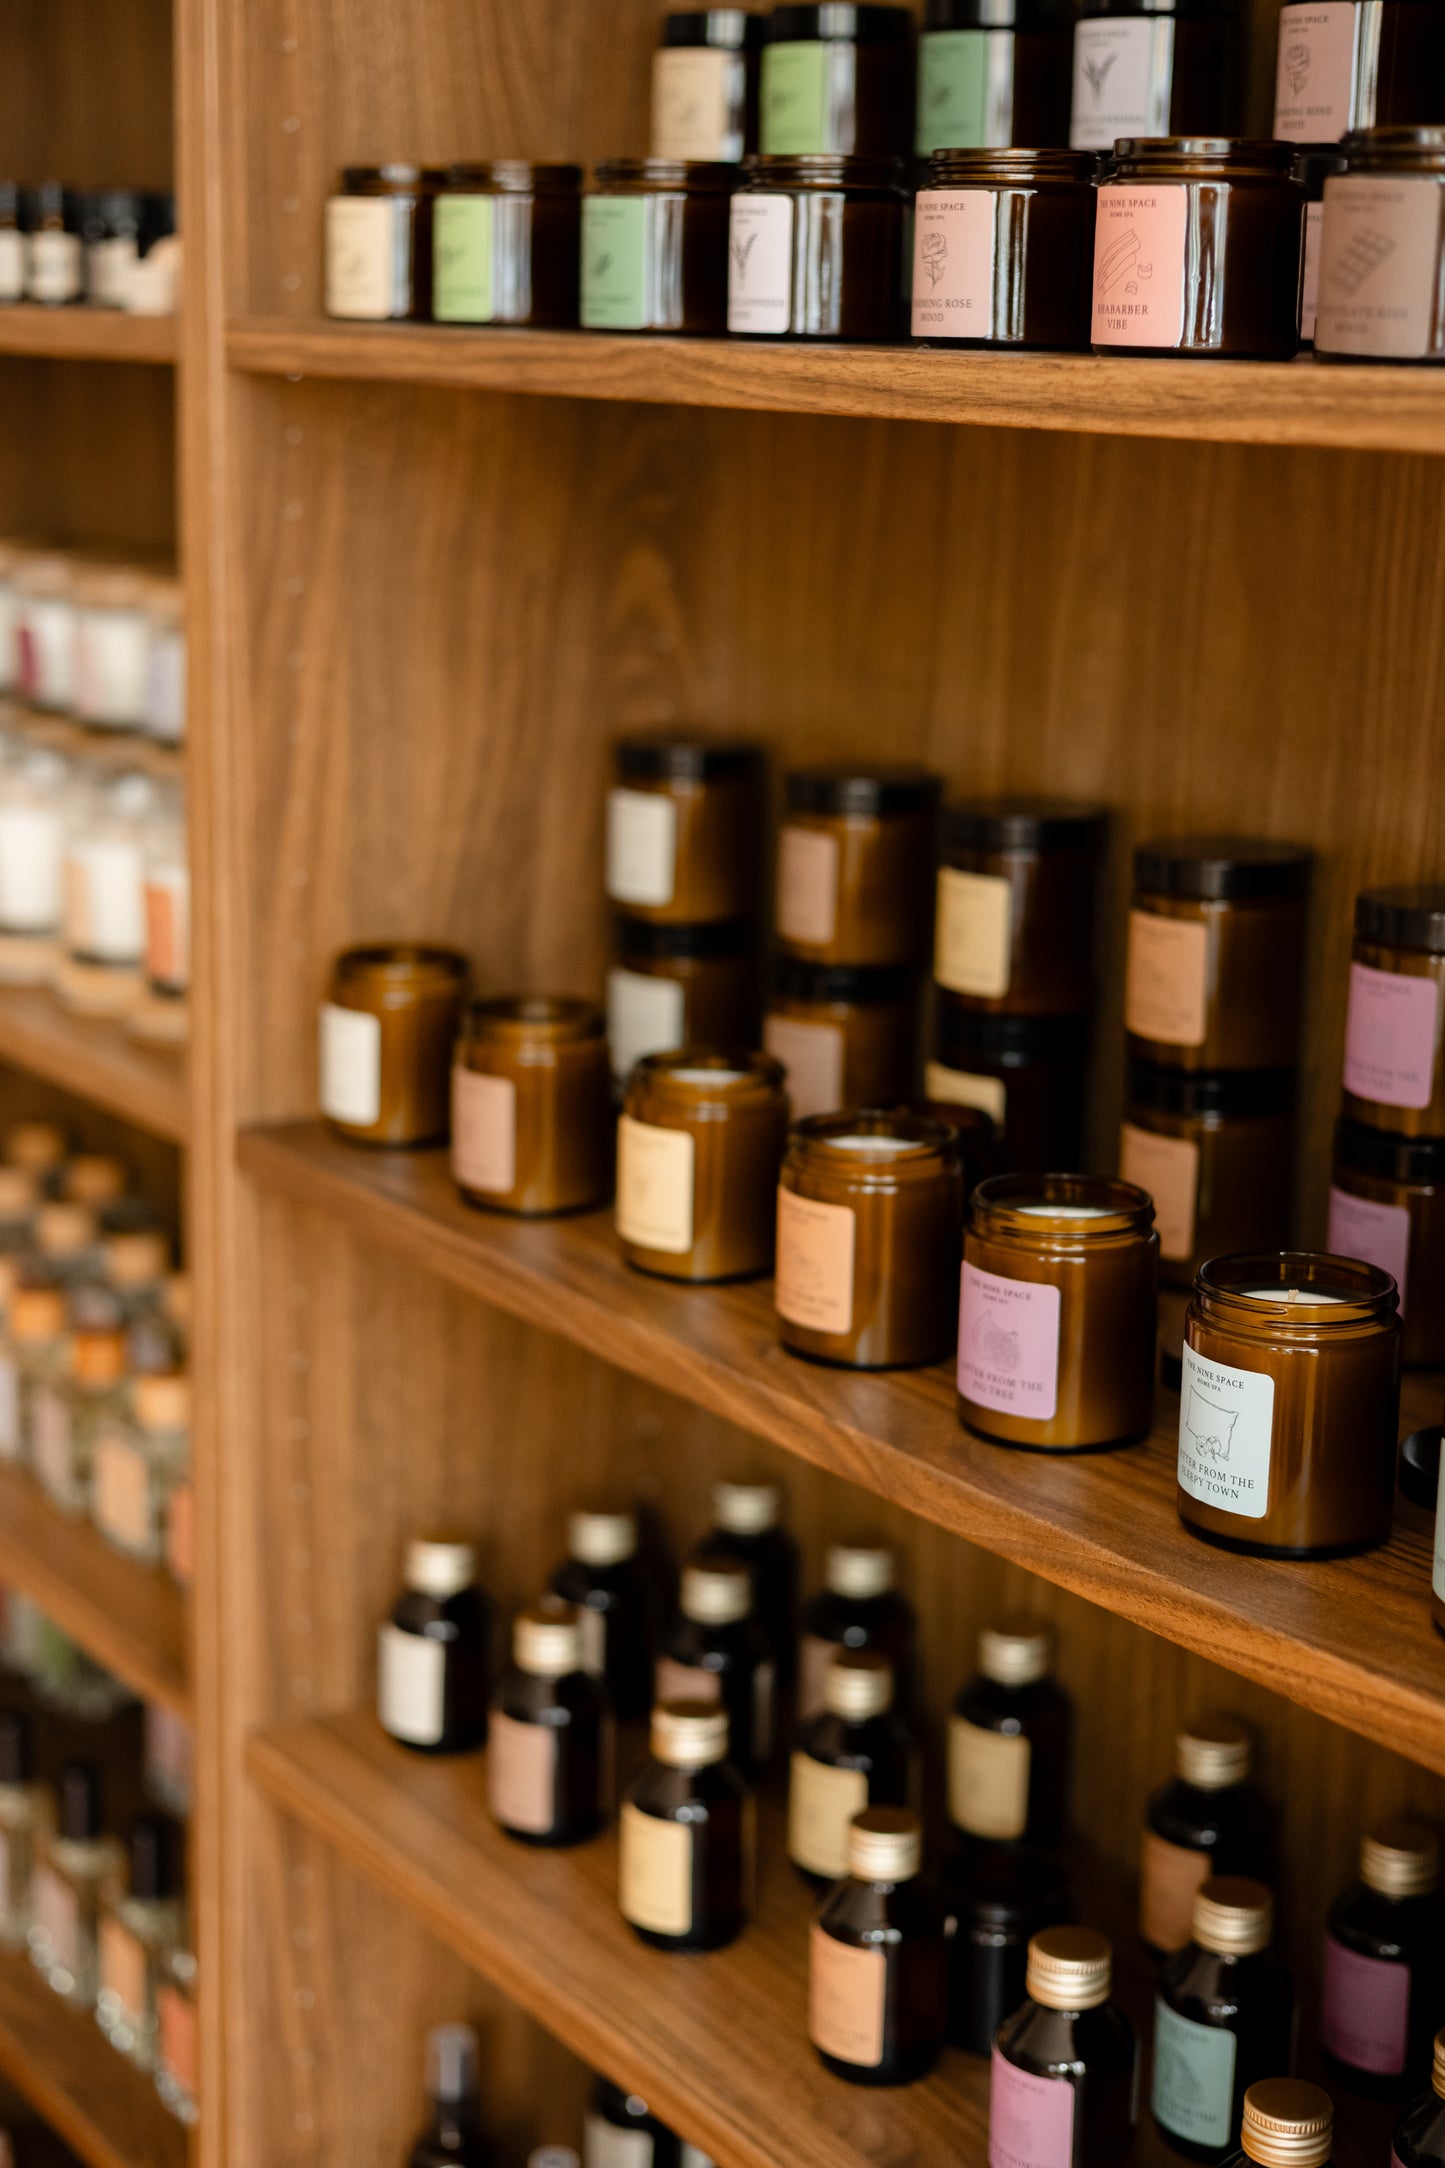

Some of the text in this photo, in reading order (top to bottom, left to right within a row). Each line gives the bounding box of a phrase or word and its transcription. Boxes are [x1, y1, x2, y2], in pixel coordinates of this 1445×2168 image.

[940, 202, 965, 211] SPACE
[1109, 199, 1126, 208] NINE
[1128, 199, 1157, 208] SPACE
[944, 298, 972, 309] ROSE
[1098, 304, 1149, 315] RHABARBER
[1108, 320, 1128, 330] VIBE
[1003, 1287, 1032, 1300] SPACE
[961, 1361, 1044, 1392] ETTER FROM THE
[1187, 1358, 1244, 1390] THE NINE SPACE
[988, 1386, 1016, 1400] TREE
[1180, 1448, 1255, 1489] ETTER FROM THE
[1182, 1464, 1240, 1499] SLEEPY TOWN
